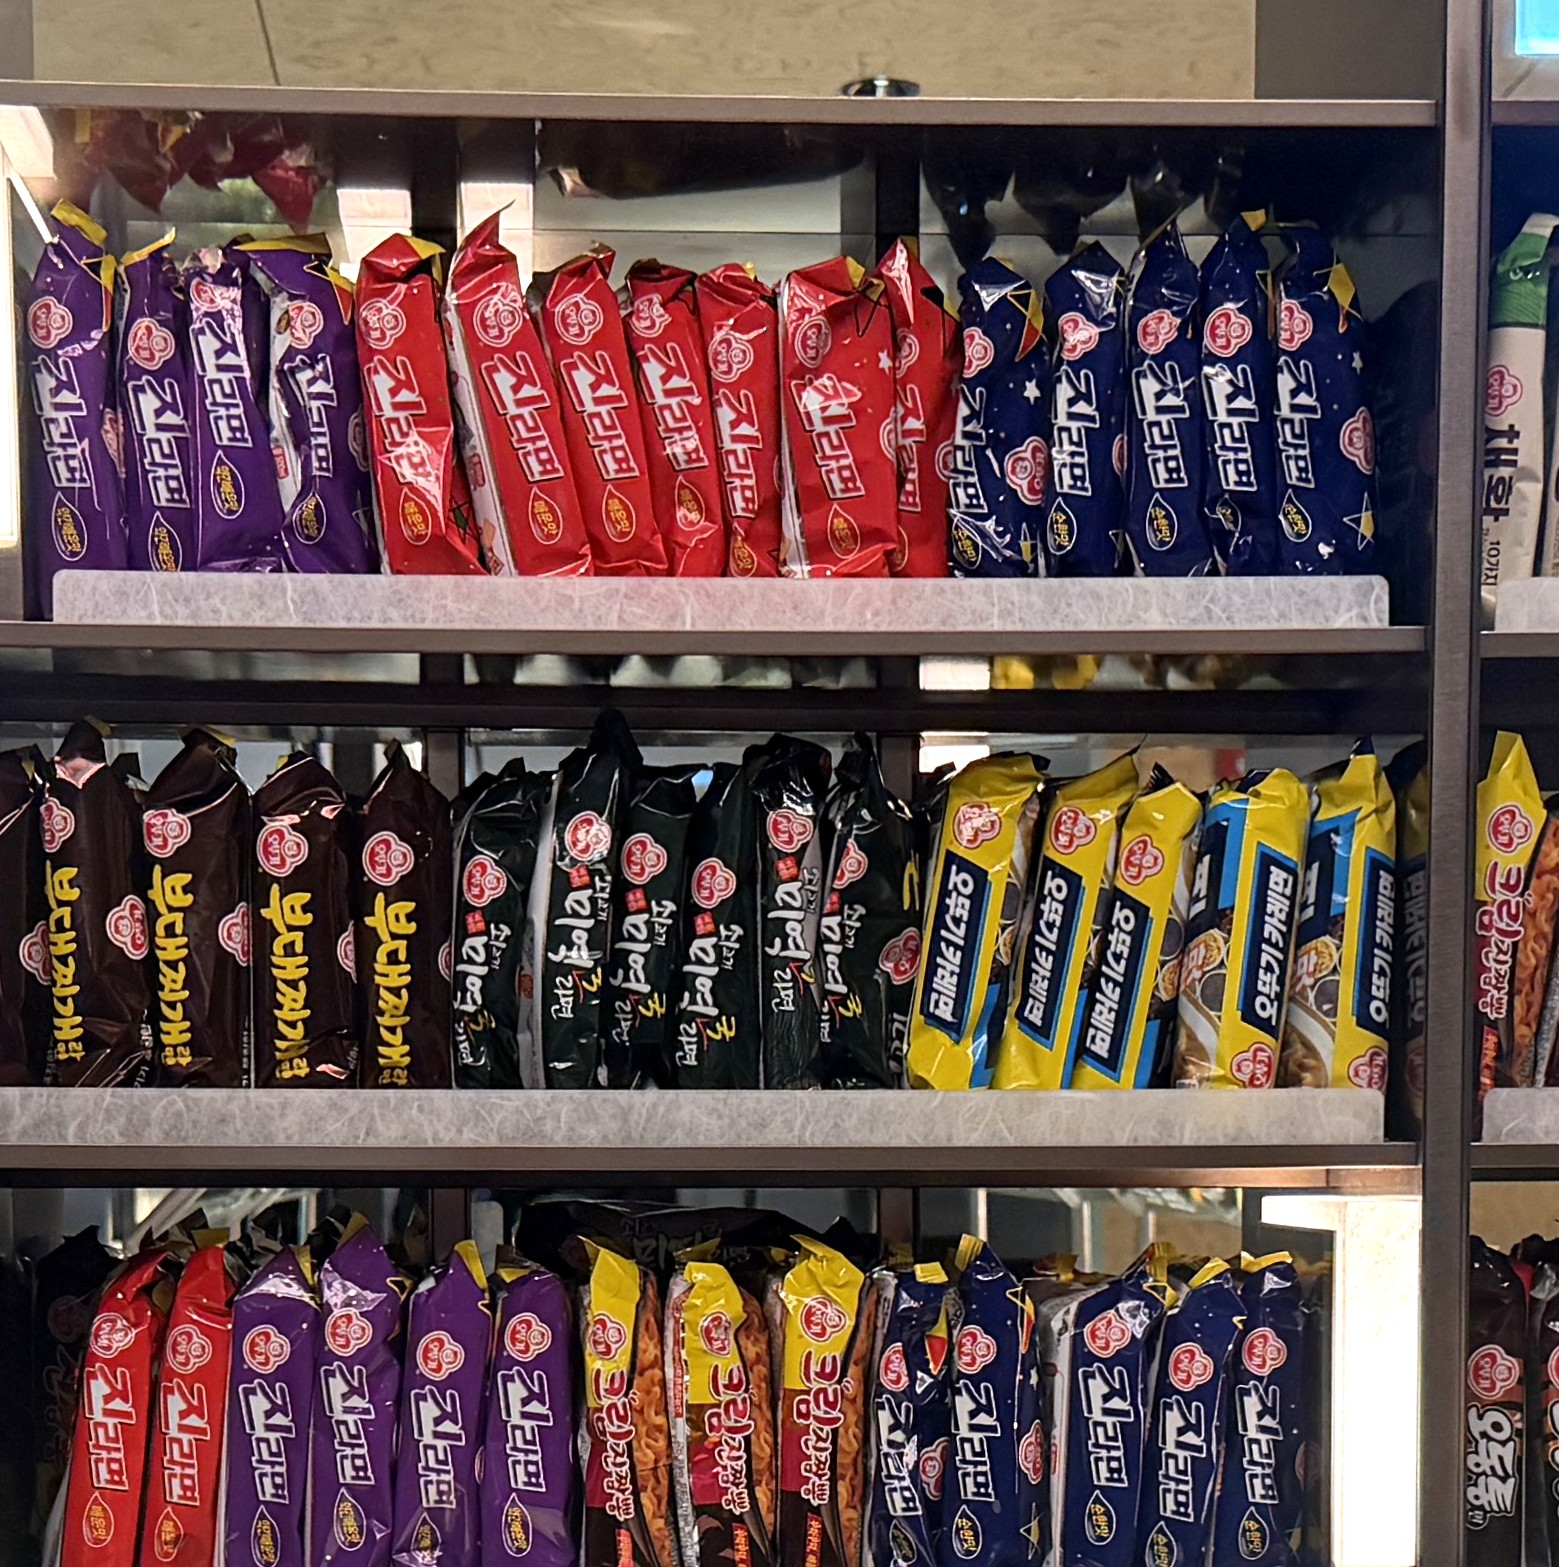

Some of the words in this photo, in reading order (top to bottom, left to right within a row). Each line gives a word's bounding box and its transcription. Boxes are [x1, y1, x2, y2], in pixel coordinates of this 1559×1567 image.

[33, 356, 90, 488] 진라면
[127, 377, 190, 509] 진라면
[190, 318, 252, 447] 진라면
[364, 356, 435, 485] 진라면
[481, 352, 564, 482] 진라면
[560, 350, 639, 480] 진라면
[641, 342, 708, 471] 진라면
[791, 374, 864, 499] 진라면
[1052, 366, 1100, 495] 진라면
[1132, 361, 1190, 488] 진라면
[1202, 365, 1258, 491] 진라면
[1274, 357, 1321, 488] 진라면
[715, 389, 762, 517] 진라면
[1053, 509, 1070, 550] 순한맛
[1151, 507, 1170, 544] 순한맛
[773, 966, 795, 1013] 라면
[929, 865, 975, 1025] 오뚜기카레면
[1023, 870, 1068, 1027] 오뚜기카레면
[1086, 906, 1136, 1059] 오뚜기카레면
[1254, 866, 1293, 1027] 오뚜기카레면
[1476, 860, 1524, 1020] 크림진짬뽕
[85, 1363, 135, 1490] 진라면
[160, 1378, 211, 1506] 진라면
[240, 1378, 295, 1505] 진라면
[320, 1361, 375, 1486] 진라면
[410, 1385, 465, 1508] 진라면
[497, 1366, 554, 1492] 진라면
[705, 1363, 755, 1514] 크림진짬뽕
[794, 1350, 841, 1506] 크림진짬뽕
[951, 1380, 1001, 1502] 진라면
[1079, 1363, 1134, 1487] 진라면
[1160, 1395, 1205, 1522] 진라면
[1236, 1381, 1284, 1504] 진라면
[1091, 1505, 1109, 1538] 순한맛
